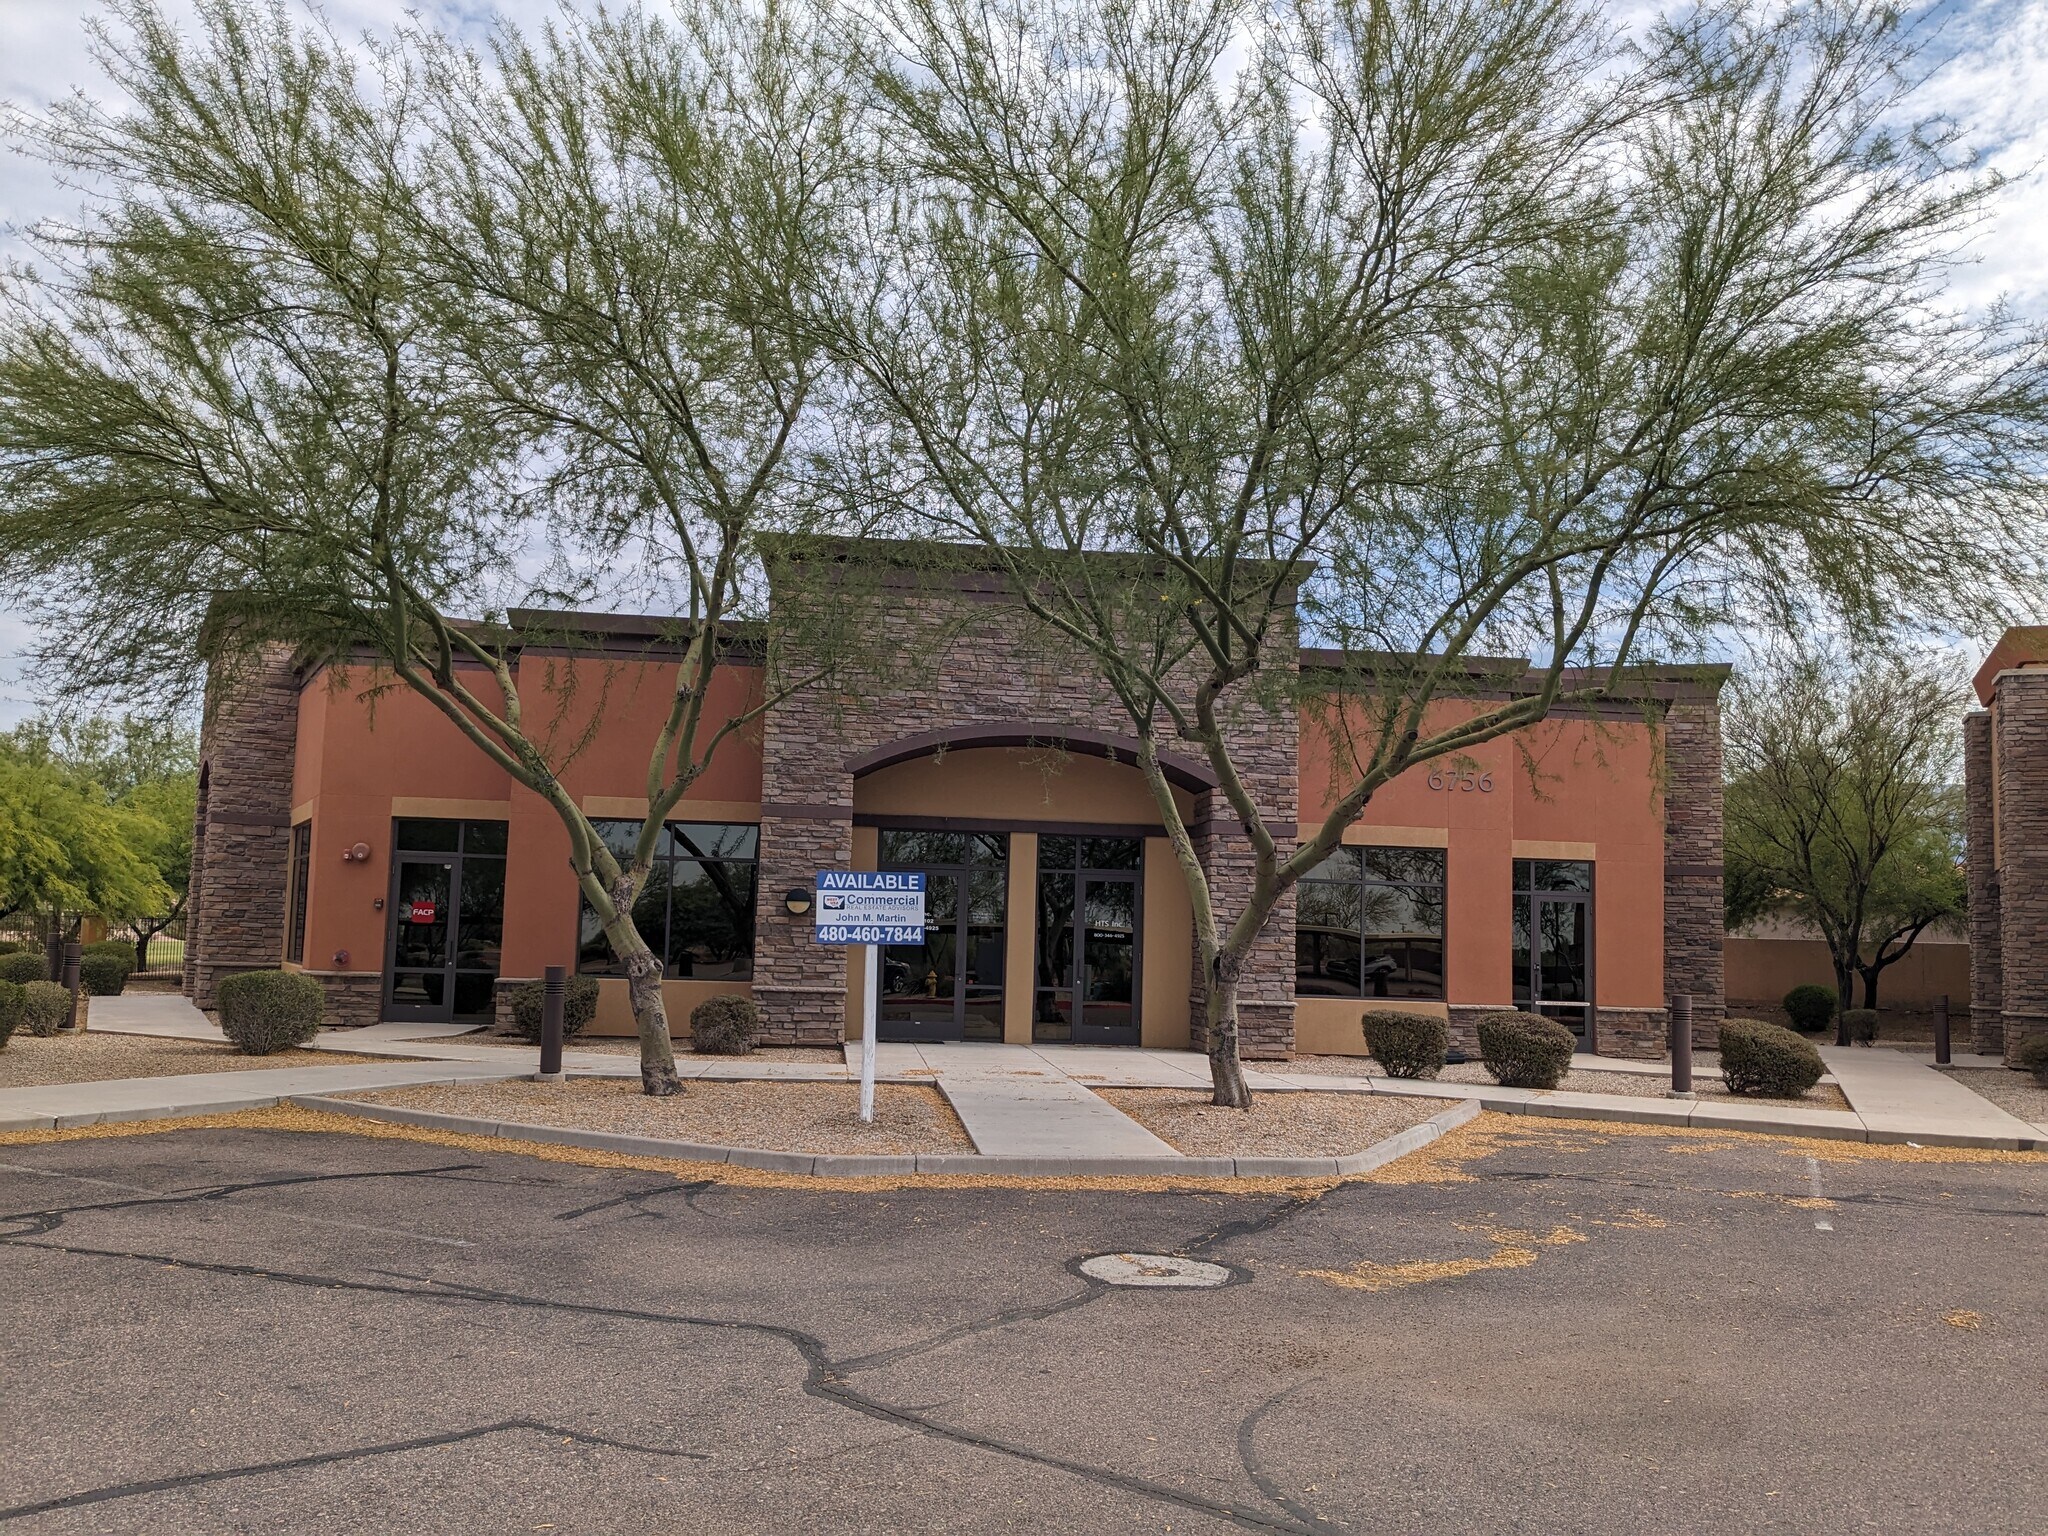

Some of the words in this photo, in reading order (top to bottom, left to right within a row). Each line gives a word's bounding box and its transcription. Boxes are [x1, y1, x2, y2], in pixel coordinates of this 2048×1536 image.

[1428, 769, 1495, 792] 6756
[823, 873, 919, 890] AVAILABLE
[847, 894, 919, 906] Commercial
[836, 914, 860, 922] John
[863, 914, 873, 922] M.
[877, 914, 906, 922] Martin
[819, 926, 922, 942] 480-460-7844
